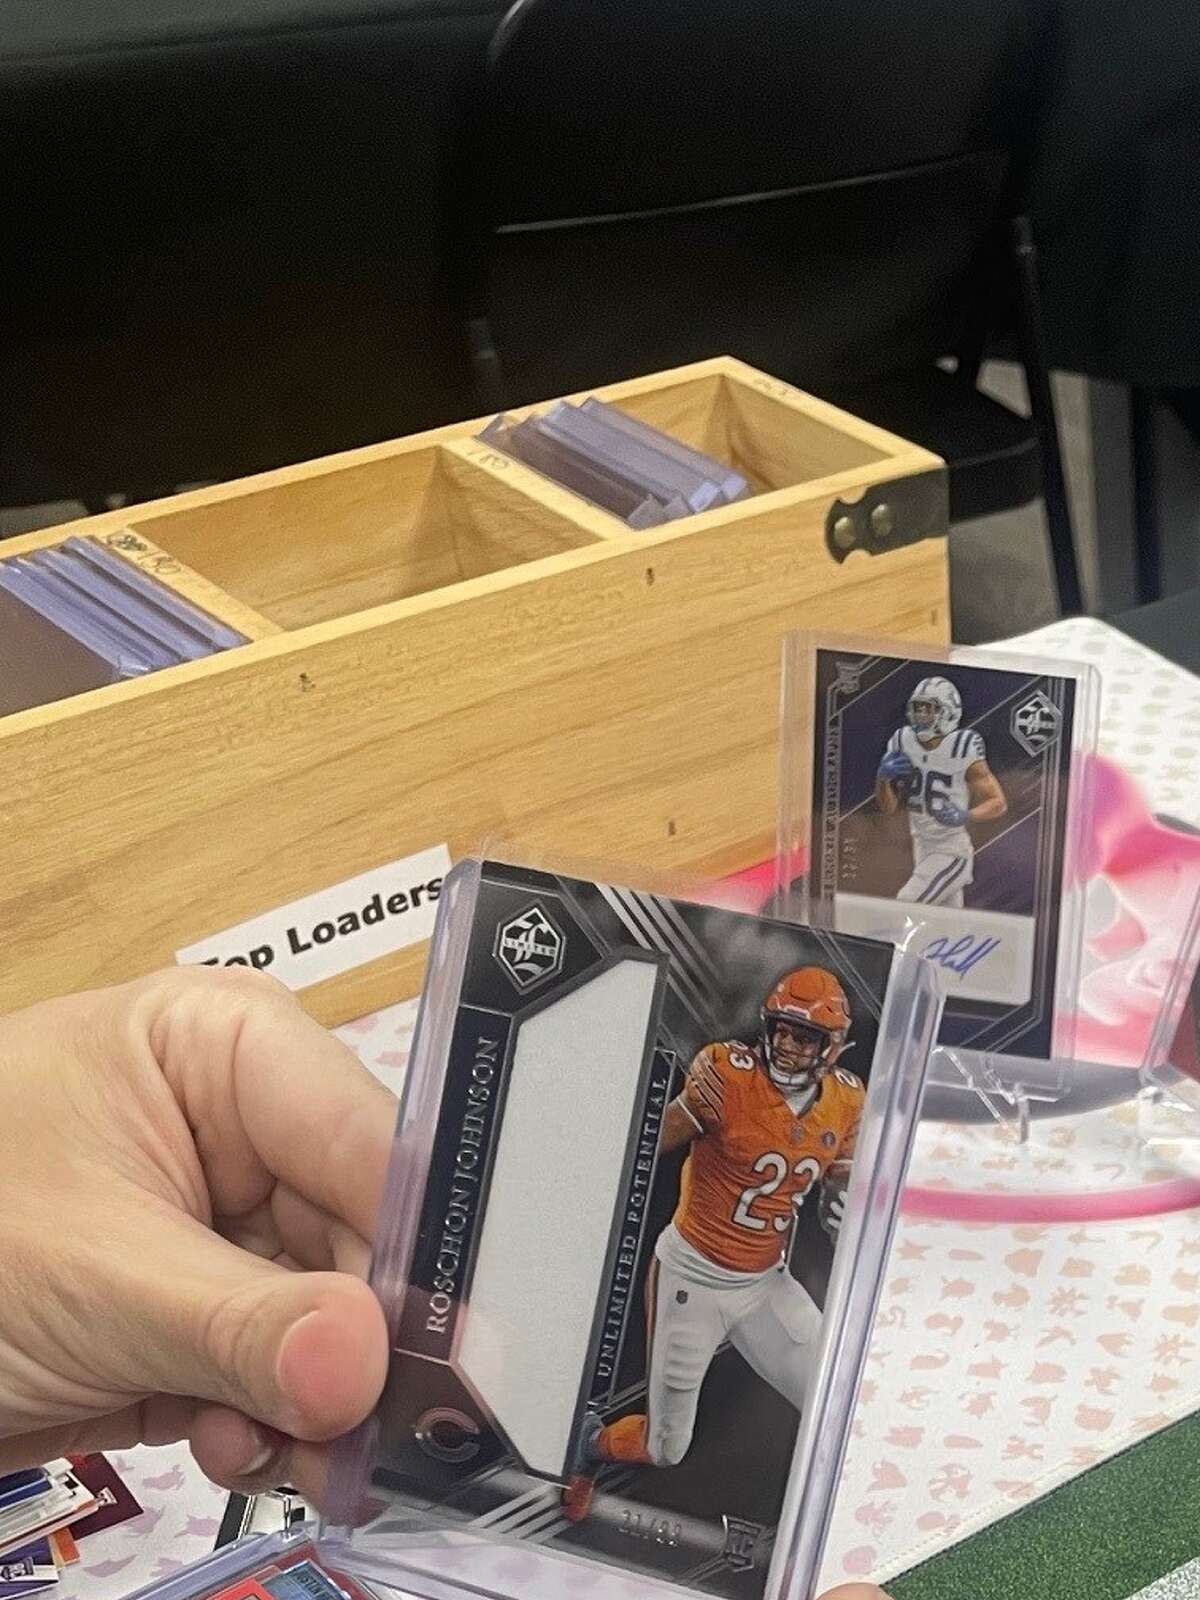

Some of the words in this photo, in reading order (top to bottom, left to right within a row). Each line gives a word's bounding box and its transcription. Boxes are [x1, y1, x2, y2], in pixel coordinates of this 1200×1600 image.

[286, 876, 444, 956] Loaders
[426, 1186, 474, 1335] ROSCHON
[454, 1036, 500, 1183] JOHNSON
[597, 1236, 637, 1379] UNLIMITED
[627, 1077, 669, 1226] POTENTIAL
